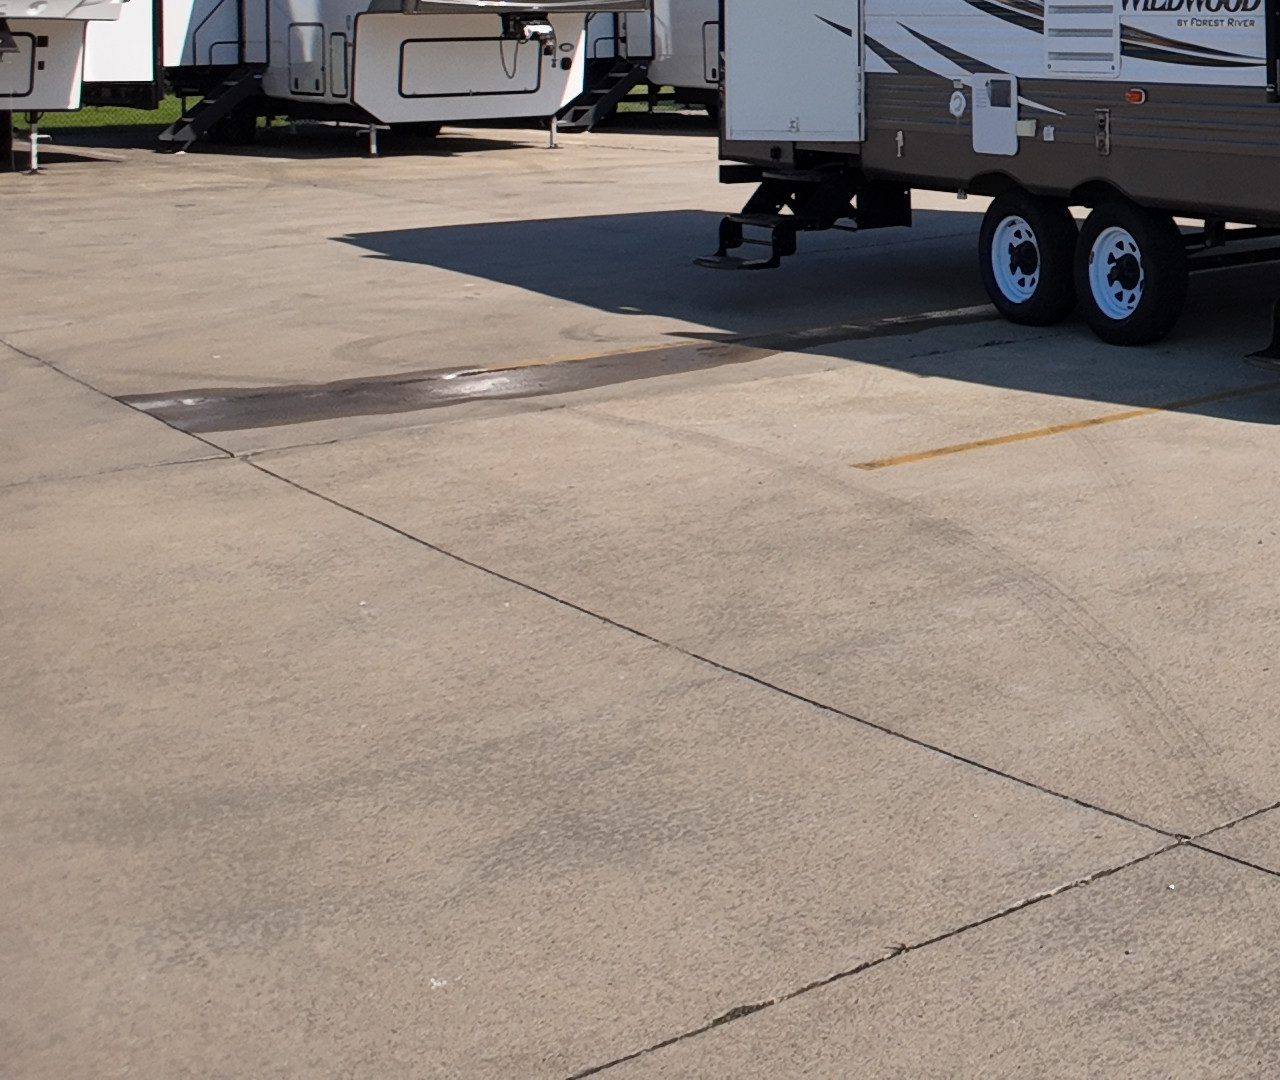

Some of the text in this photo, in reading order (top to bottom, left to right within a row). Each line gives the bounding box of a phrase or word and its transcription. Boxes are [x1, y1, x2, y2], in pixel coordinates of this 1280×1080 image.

[1177, 17, 1255, 27] BY FOREST RIVER
